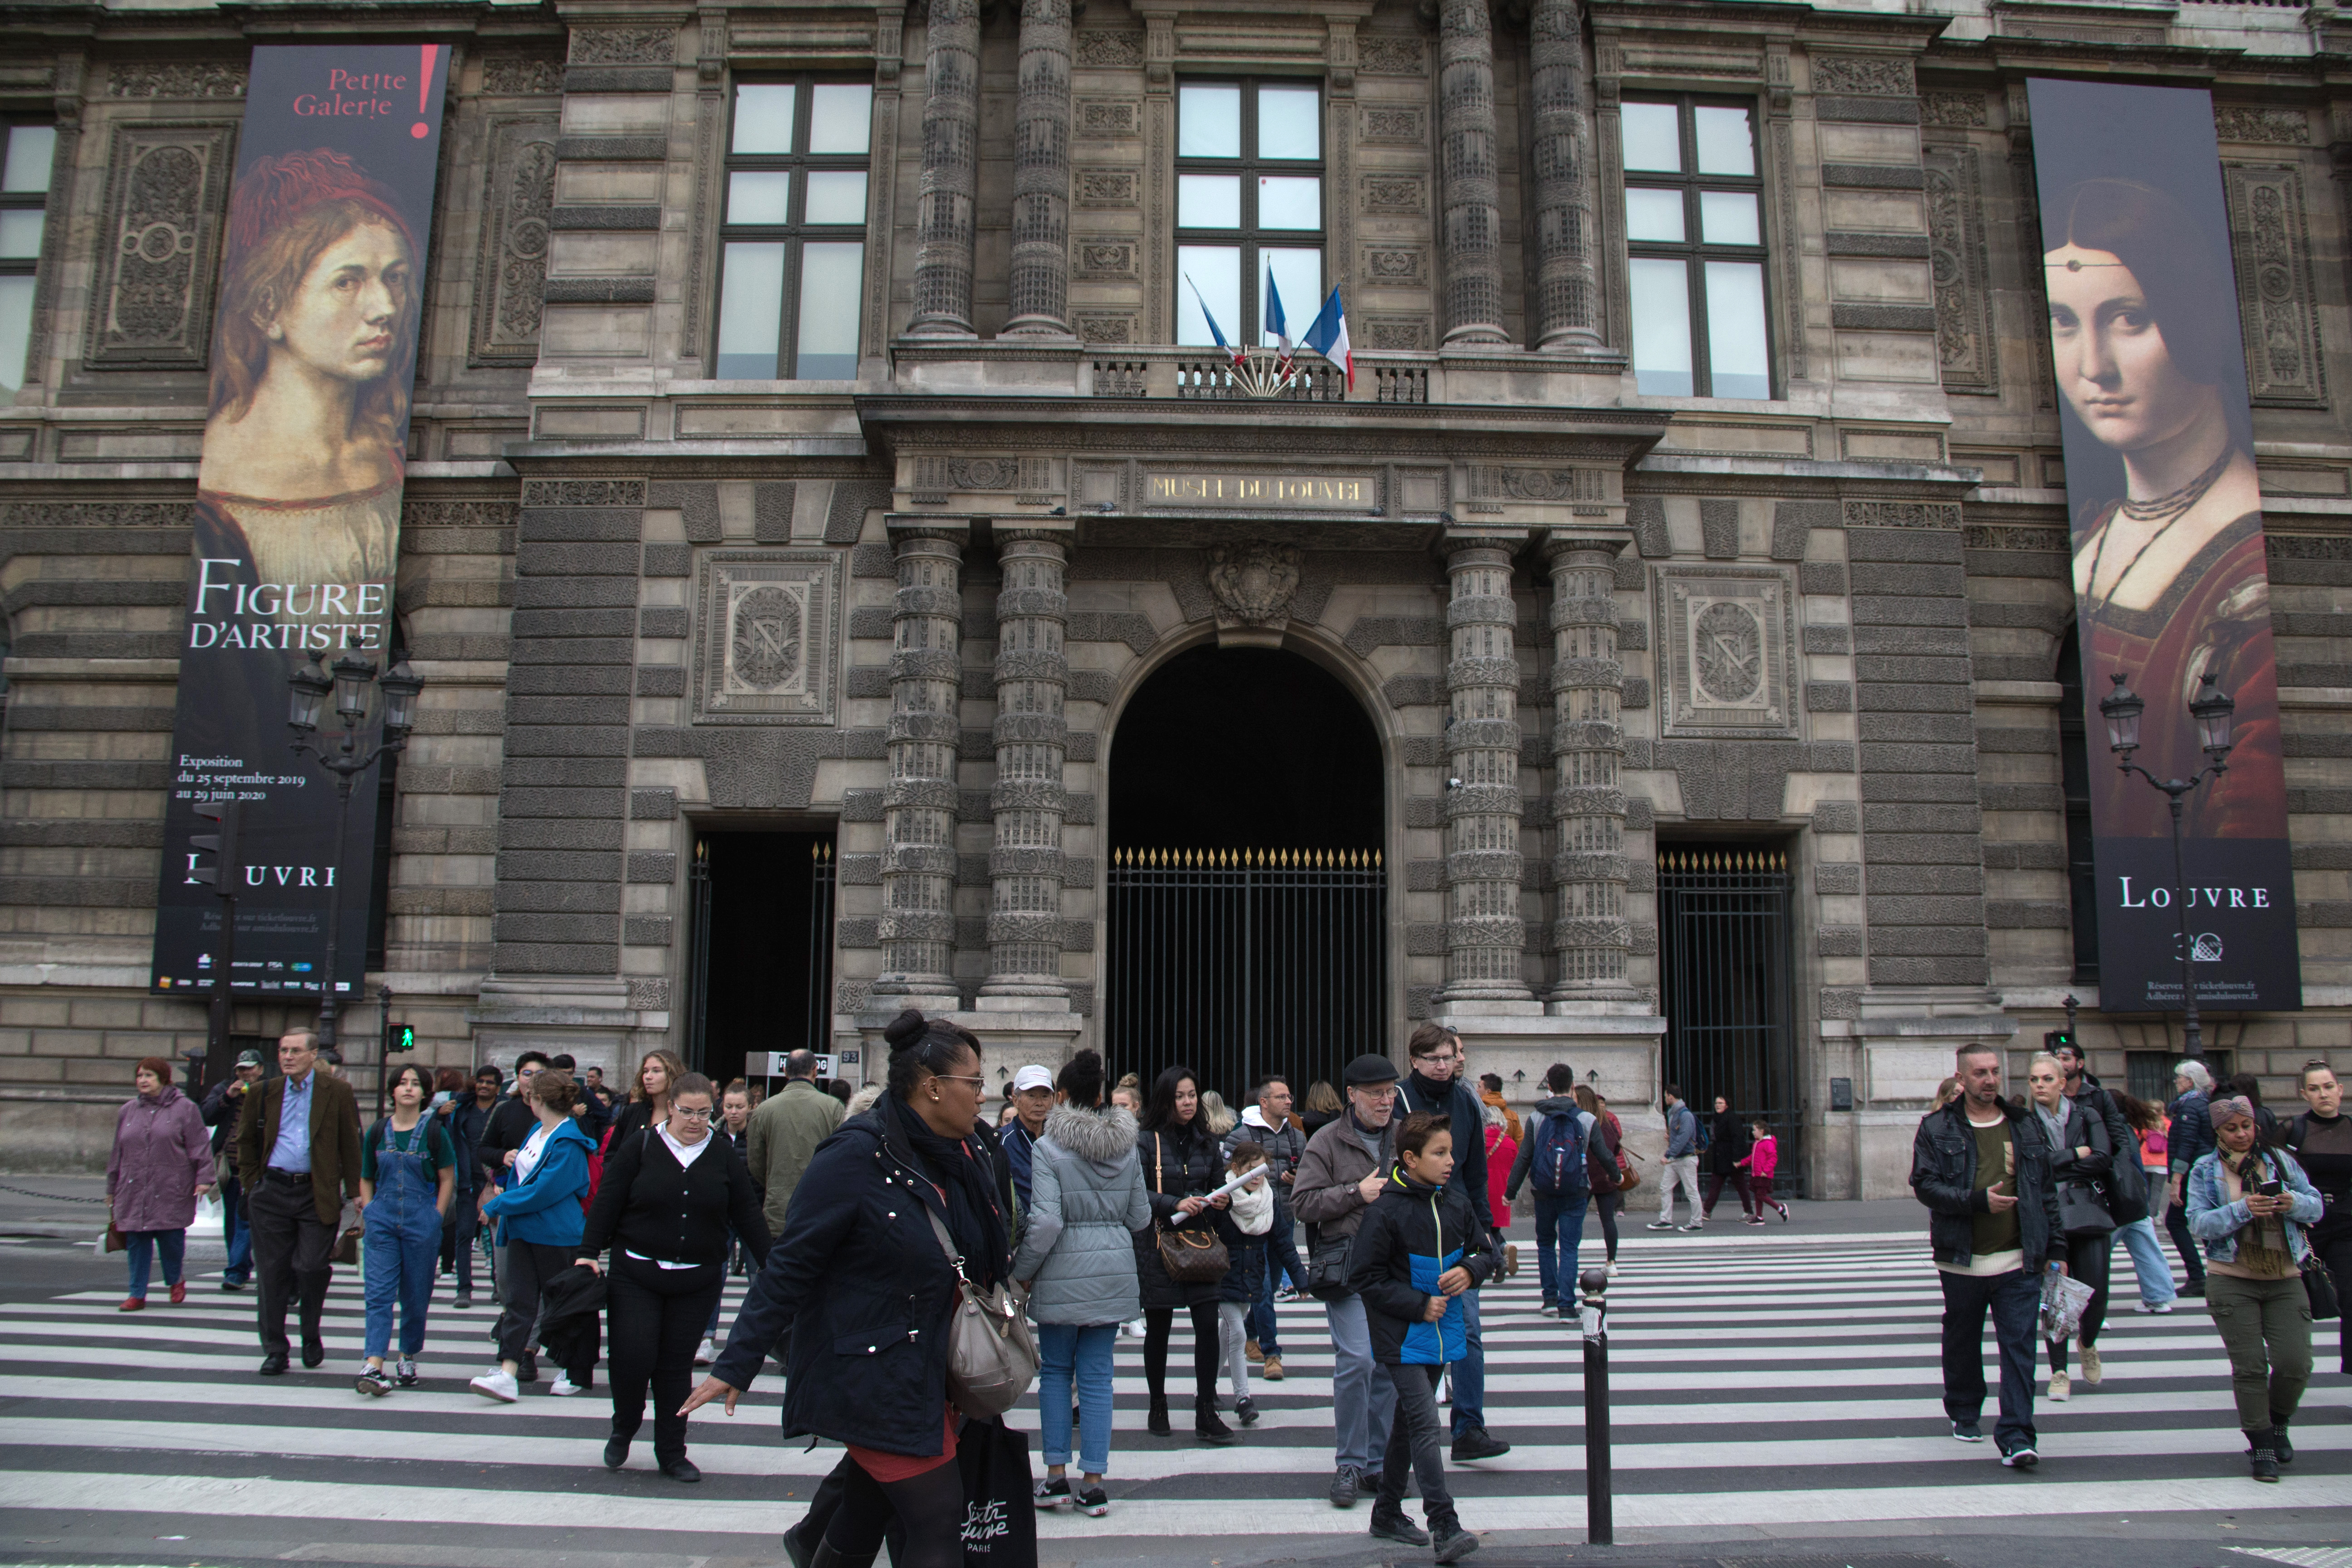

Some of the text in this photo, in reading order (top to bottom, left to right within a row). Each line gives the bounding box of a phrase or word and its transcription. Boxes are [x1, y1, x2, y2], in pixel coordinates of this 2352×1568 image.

[1240, 480, 1269, 499] DU
[1279, 480, 1368, 500] LOUVRE
[193, 559, 386, 615] FIGURE
[179, 754, 243, 770] Exposition
[177, 770, 306, 788] du 25 septembre 2019
[194, 790, 209, 802] 29
[210, 787, 235, 802] juin
[238, 791, 267, 800] 2020
[843, 1052, 857, 1062] 93
[961, 1498, 1007, 1526] Sixth
